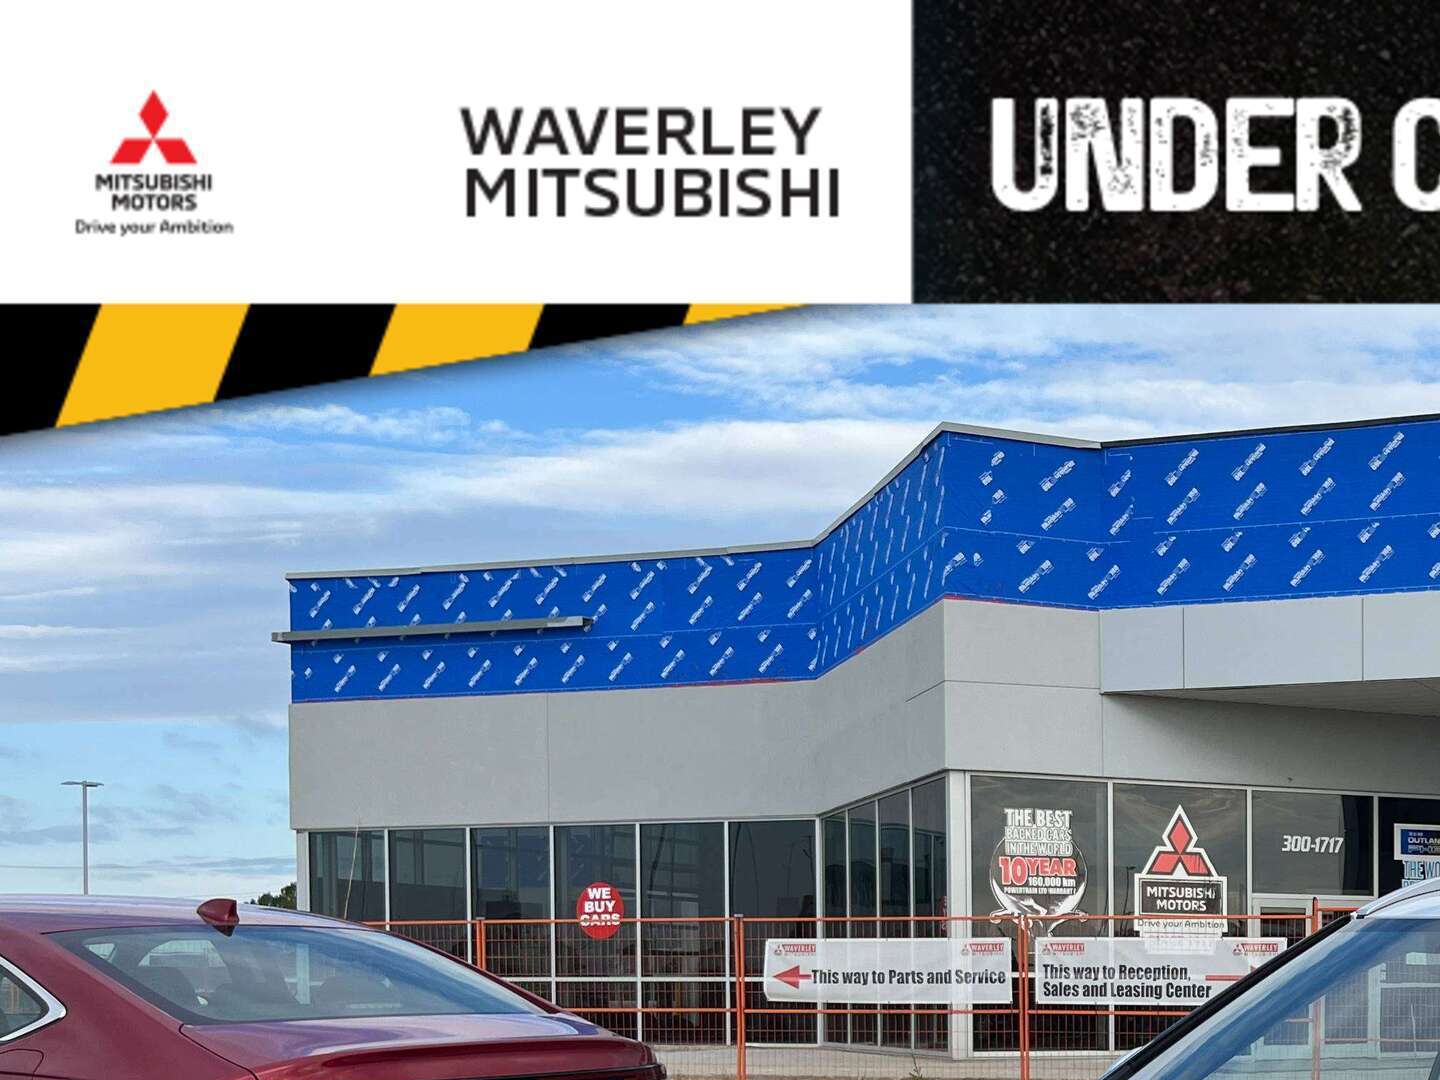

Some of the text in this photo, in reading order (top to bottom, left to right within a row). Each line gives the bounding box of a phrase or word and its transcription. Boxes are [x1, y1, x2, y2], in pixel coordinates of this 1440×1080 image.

[1004, 808, 1073, 827] THE BEST
[1006, 828, 1072, 841] BACKED CARS
[1007, 841, 1073, 856] IN THE WORLD
[1281, 835, 1344, 853] 300-1717
[999, 856, 1077, 885] 10 YEAR
[1403, 860, 1424, 880] THE
[1063, 877, 1076, 887] km
[587, 888, 611, 899] WE
[1146, 887, 1215, 899] MITSUBISHI
[584, 901, 616, 913] BUY
[1156, 899, 1207, 911] MOTORS
[580, 914, 620, 926] CARS
[1138, 919, 1161, 928] Drive
[1184, 920, 1224, 928] Ambition
[812, 969, 1006, 986] This way to Parts and Service
[1043, 964, 1191, 981] This way to Reception,
[1043, 982, 1212, 999] Sales and Leasing Center
